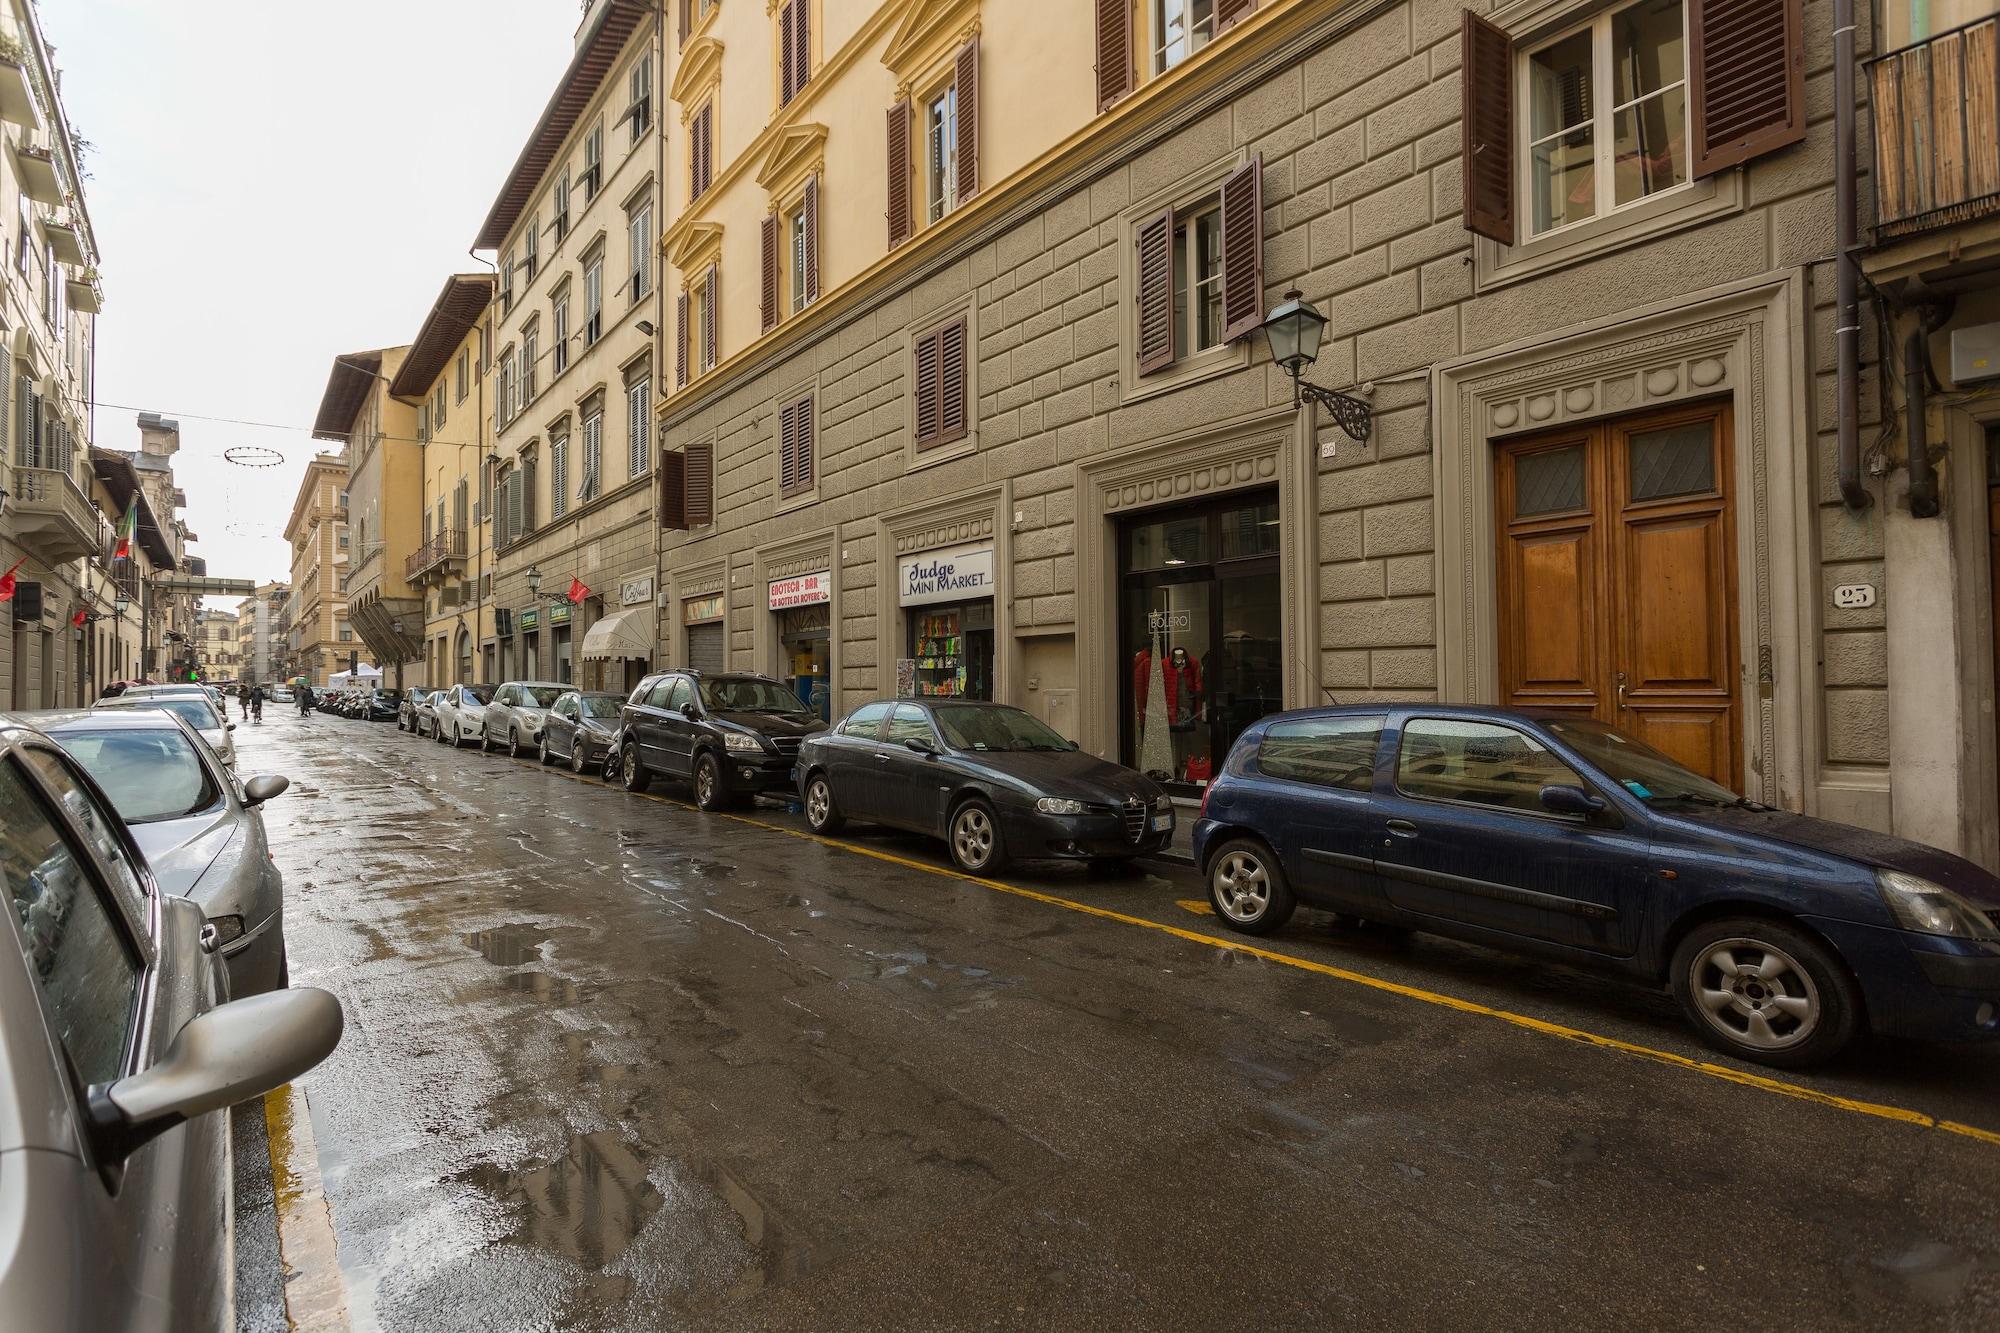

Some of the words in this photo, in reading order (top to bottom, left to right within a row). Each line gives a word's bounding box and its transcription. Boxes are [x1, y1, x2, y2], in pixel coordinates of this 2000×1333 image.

[909, 560, 954, 581] Judge
[771, 580, 800, 596] ENOTECA
[805, 577, 818, 590] BAR
[909, 580, 934, 595] MINI
[937, 572, 985, 592] MARKET
[778, 596, 792, 606] BOTTE
[794, 594, 800, 604] DI
[1151, 615, 1188, 628] BOLERO
